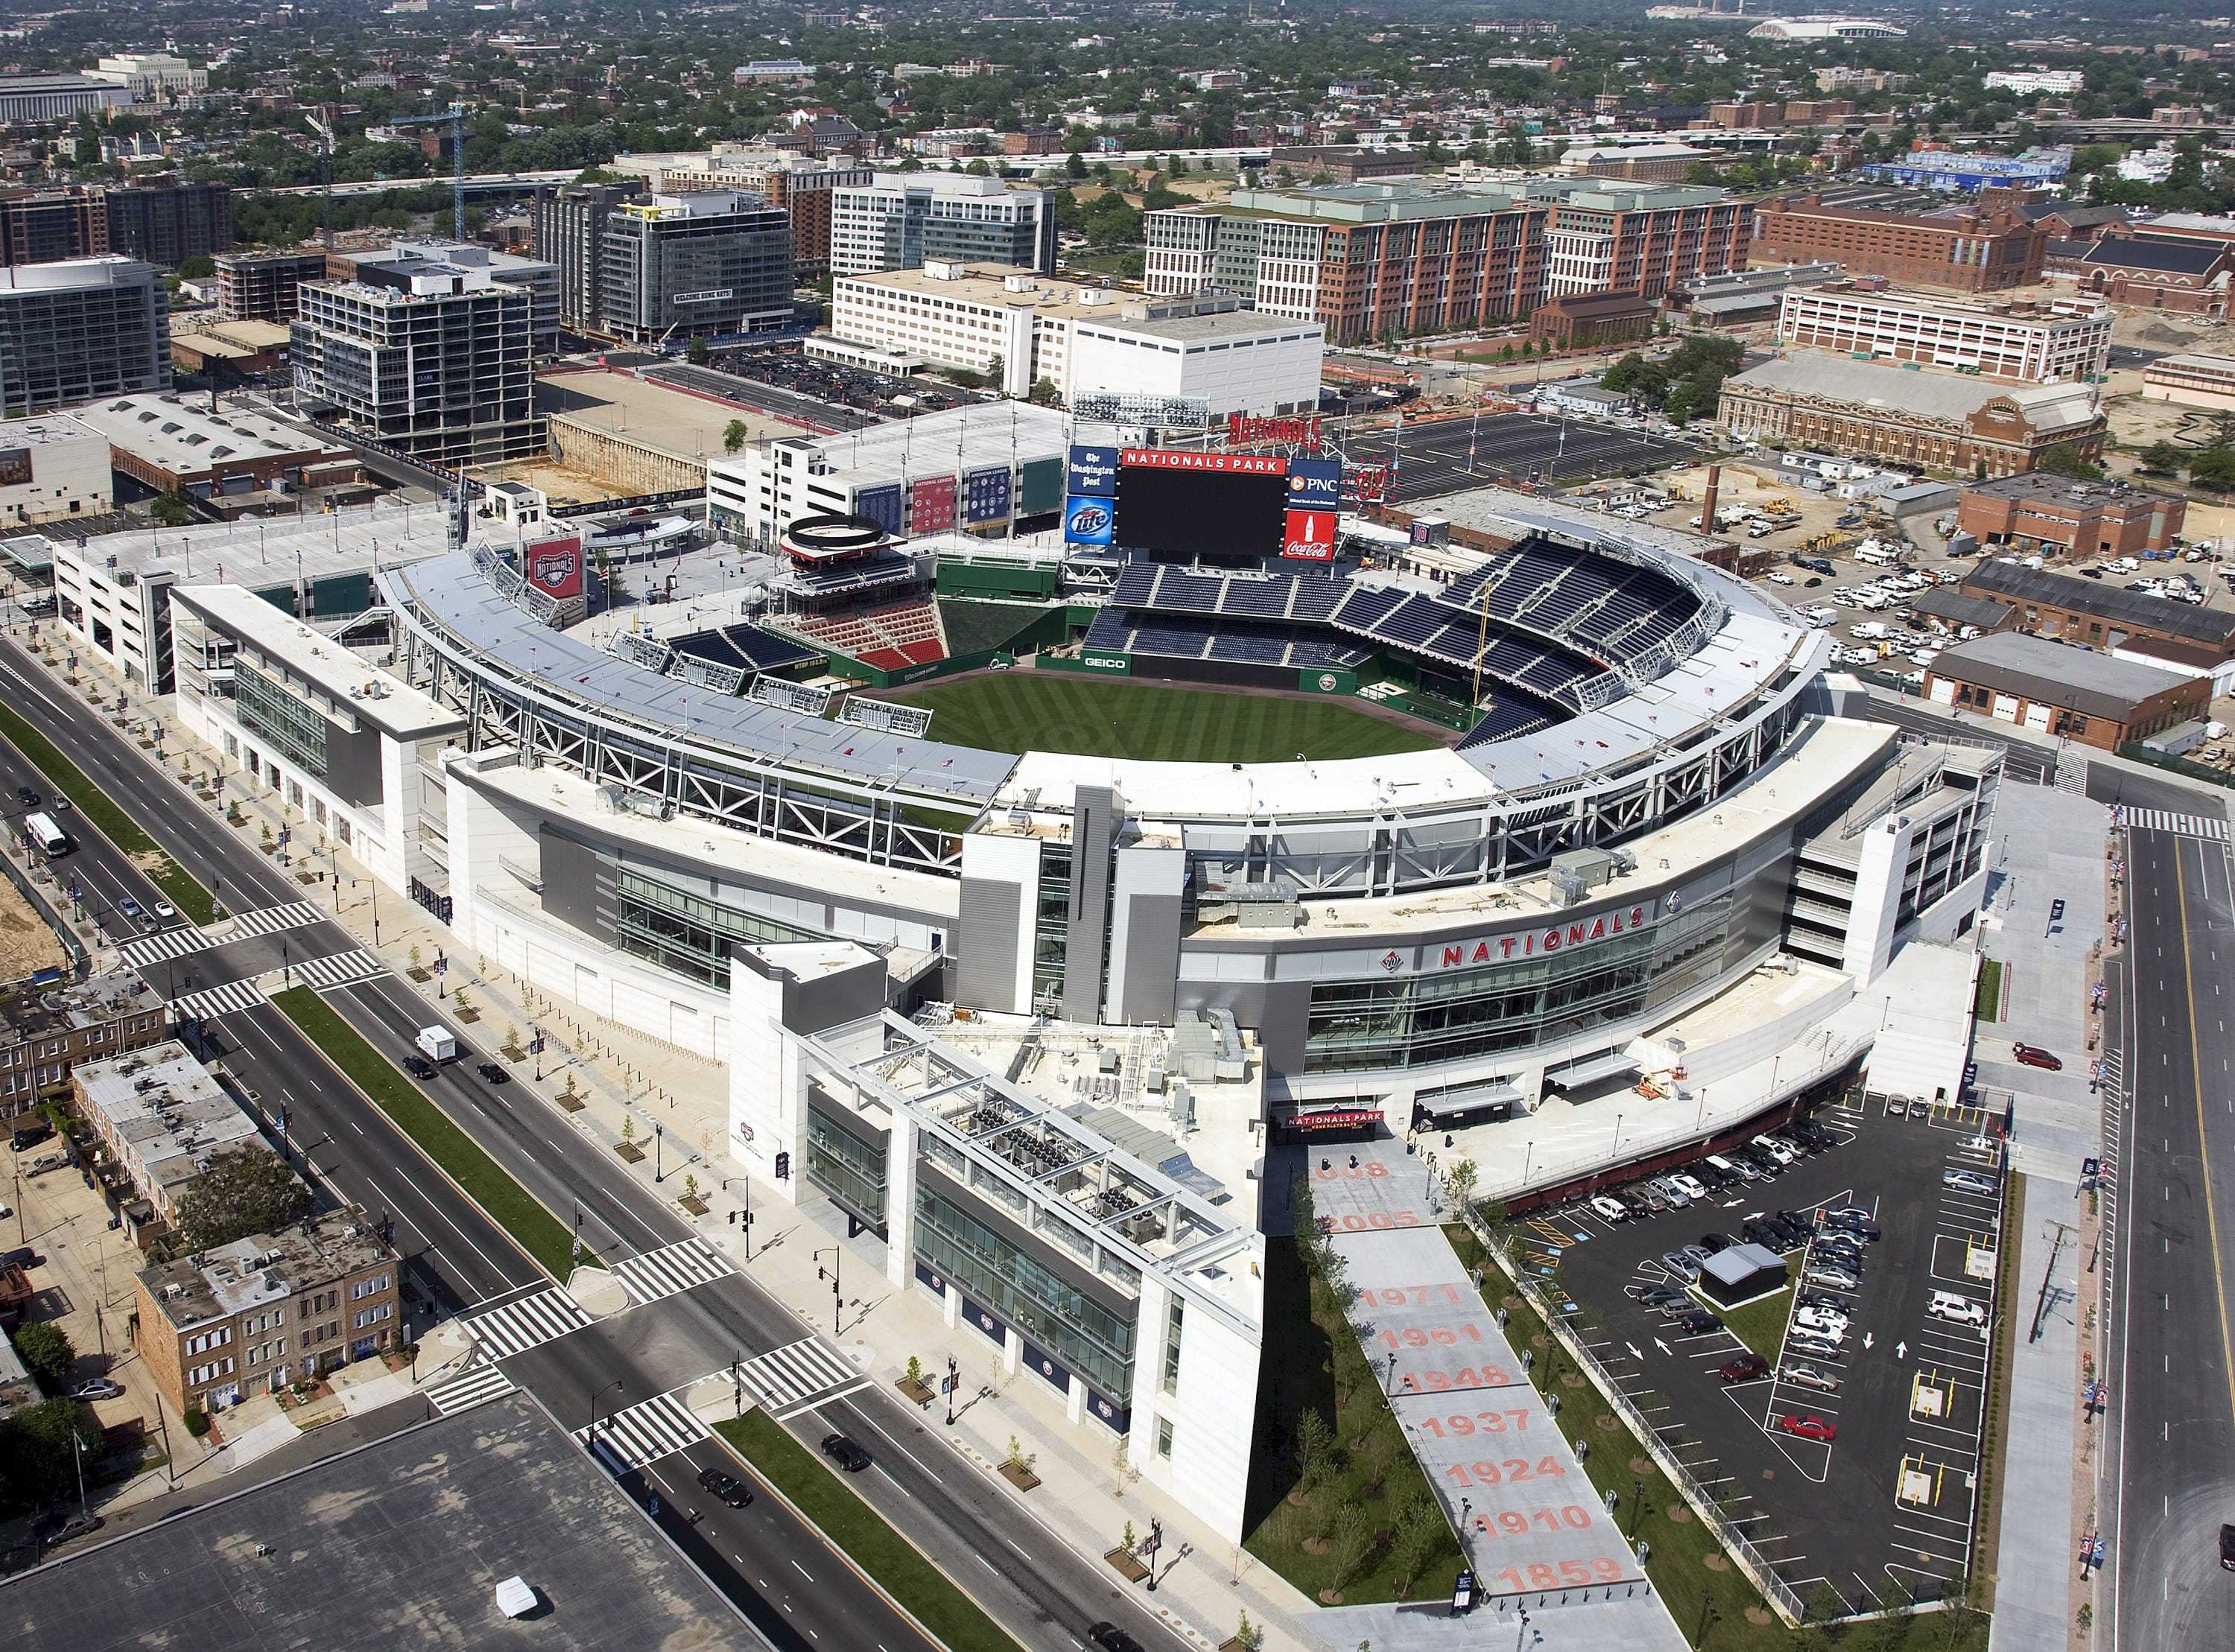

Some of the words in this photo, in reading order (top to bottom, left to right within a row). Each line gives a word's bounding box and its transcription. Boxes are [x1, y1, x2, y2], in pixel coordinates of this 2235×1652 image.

[676, 293, 700, 302] WELCOME
[1229, 413, 1322, 451] NATIONALS
[1085, 453, 1100, 463] The
[1127, 453, 1224, 468] NATIONALS
[1233, 460, 1277, 471] PARK
[1071, 462, 1115, 476] Washington
[1082, 477, 1100, 487] Post
[1307, 478, 1337, 492] PNC
[1414, 525, 1427, 542] 10
[1287, 541, 1331, 558] Coca-Cola
[536, 557, 573, 577] NATIONALS
[1085, 658, 1126, 669] GEICO
[1442, 907, 1643, 967] NATIONALS
[1289, 1116, 1350, 1125] NATIONALS
[1354, 1113, 1380, 1122] PARK
[1357, 1283, 1459, 1308] 1971
[1378, 1324, 1483, 1349] 1961
[1398, 1365, 1510, 1391] 1948
[1421, 1409, 1529, 1438] 1937
[1445, 1456, 1565, 1487] 1924
[1471, 1505, 1591, 1537] 1910
[1498, 1557, 1622, 1592] 1859
